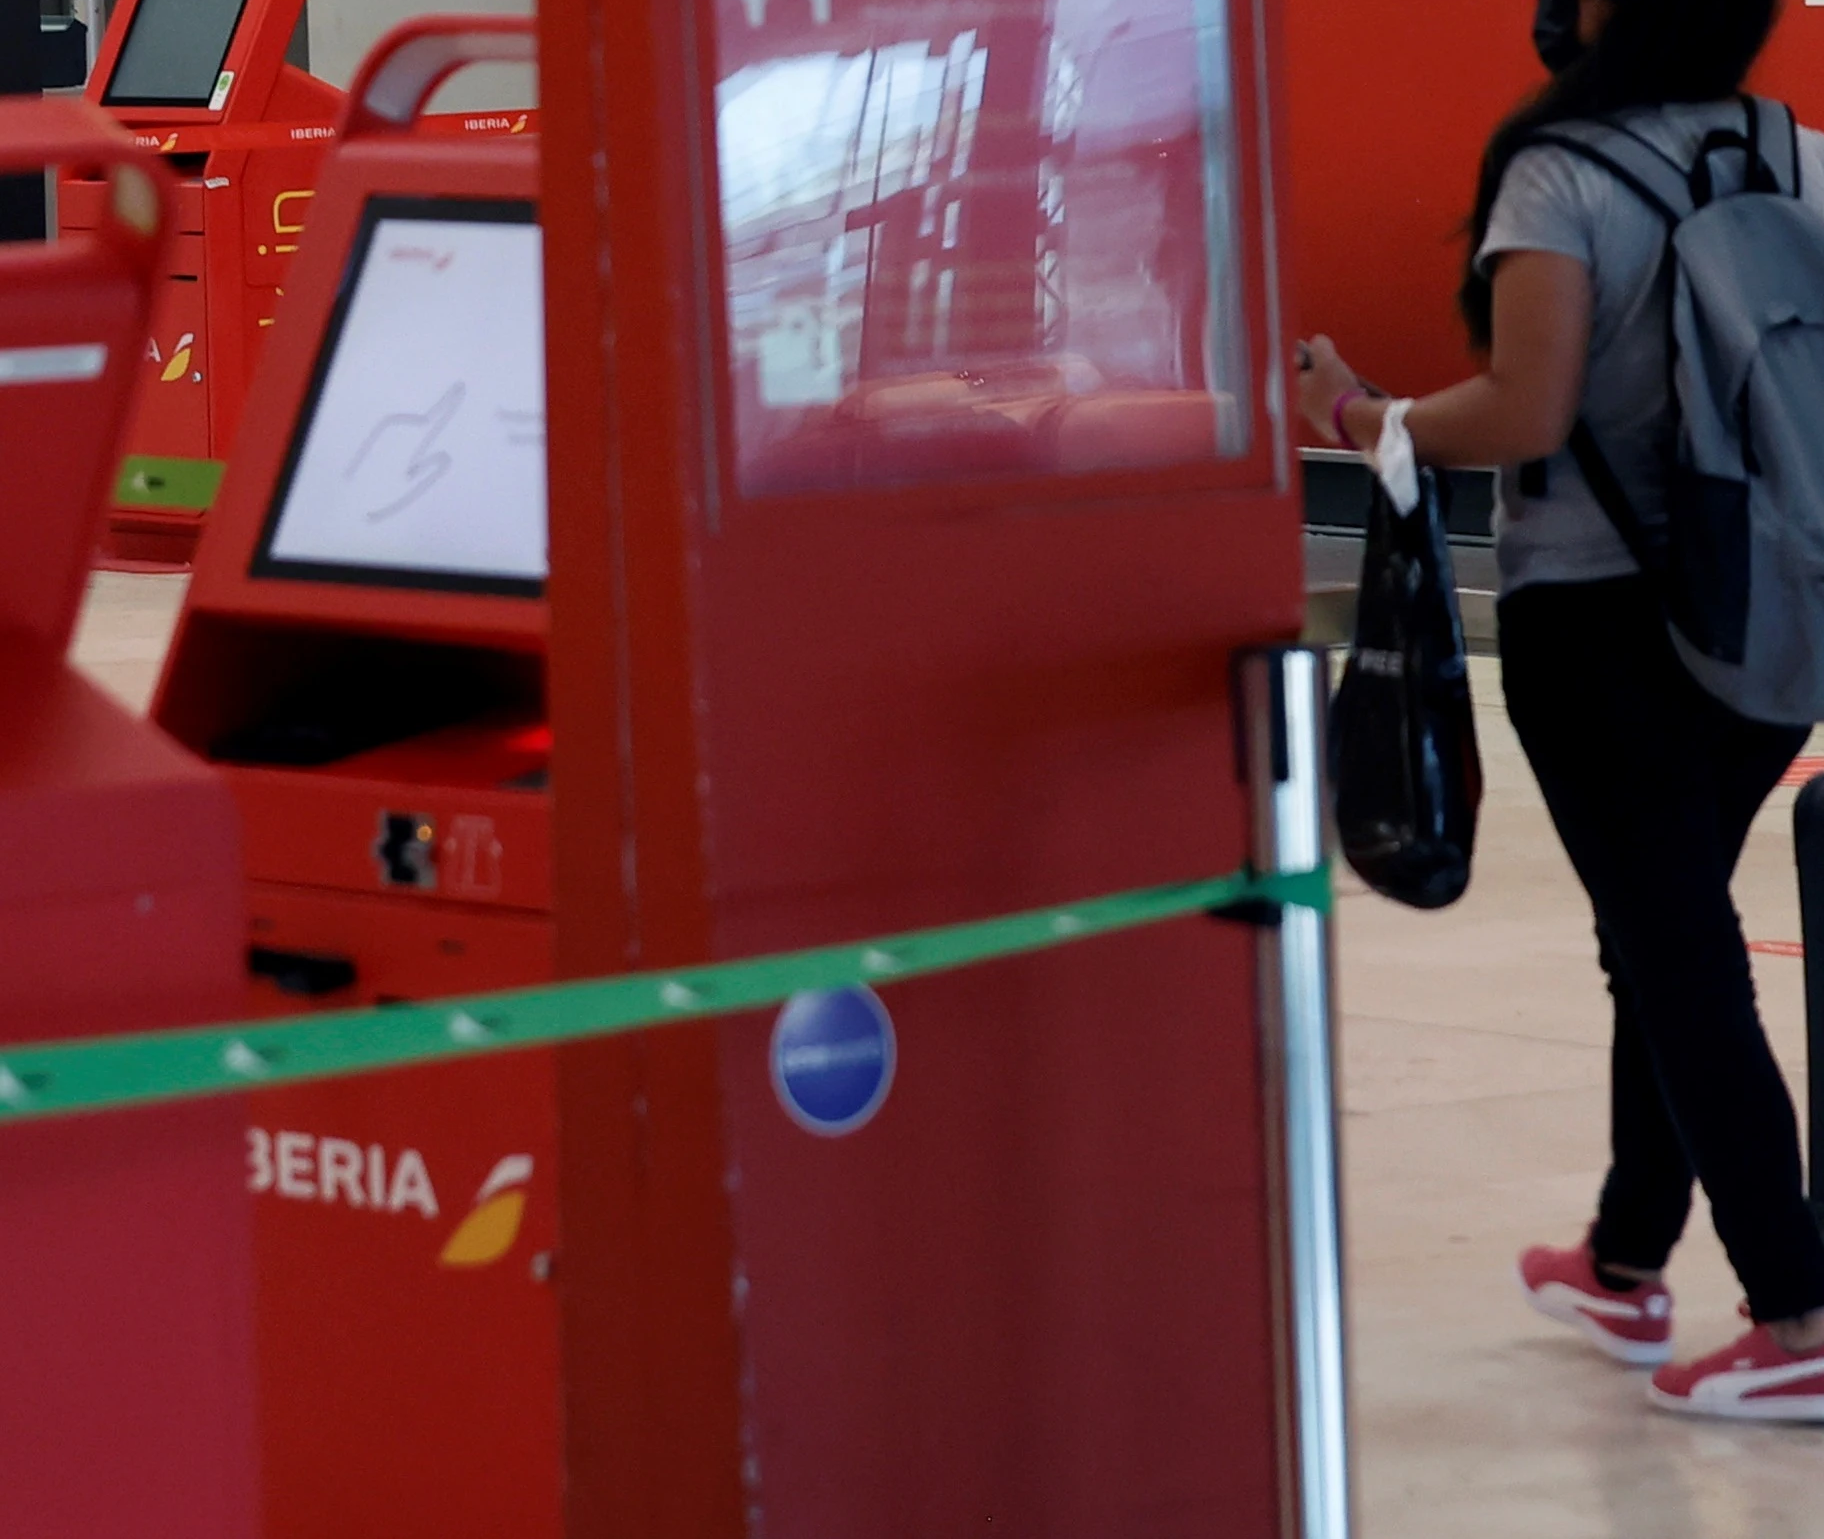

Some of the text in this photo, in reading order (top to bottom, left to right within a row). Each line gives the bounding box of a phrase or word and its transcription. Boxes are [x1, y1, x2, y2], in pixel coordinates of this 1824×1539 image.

[464, 117, 510, 132] IBERIA
[135, 135, 160, 147] RIA
[245, 1125, 439, 1220] BERIA
